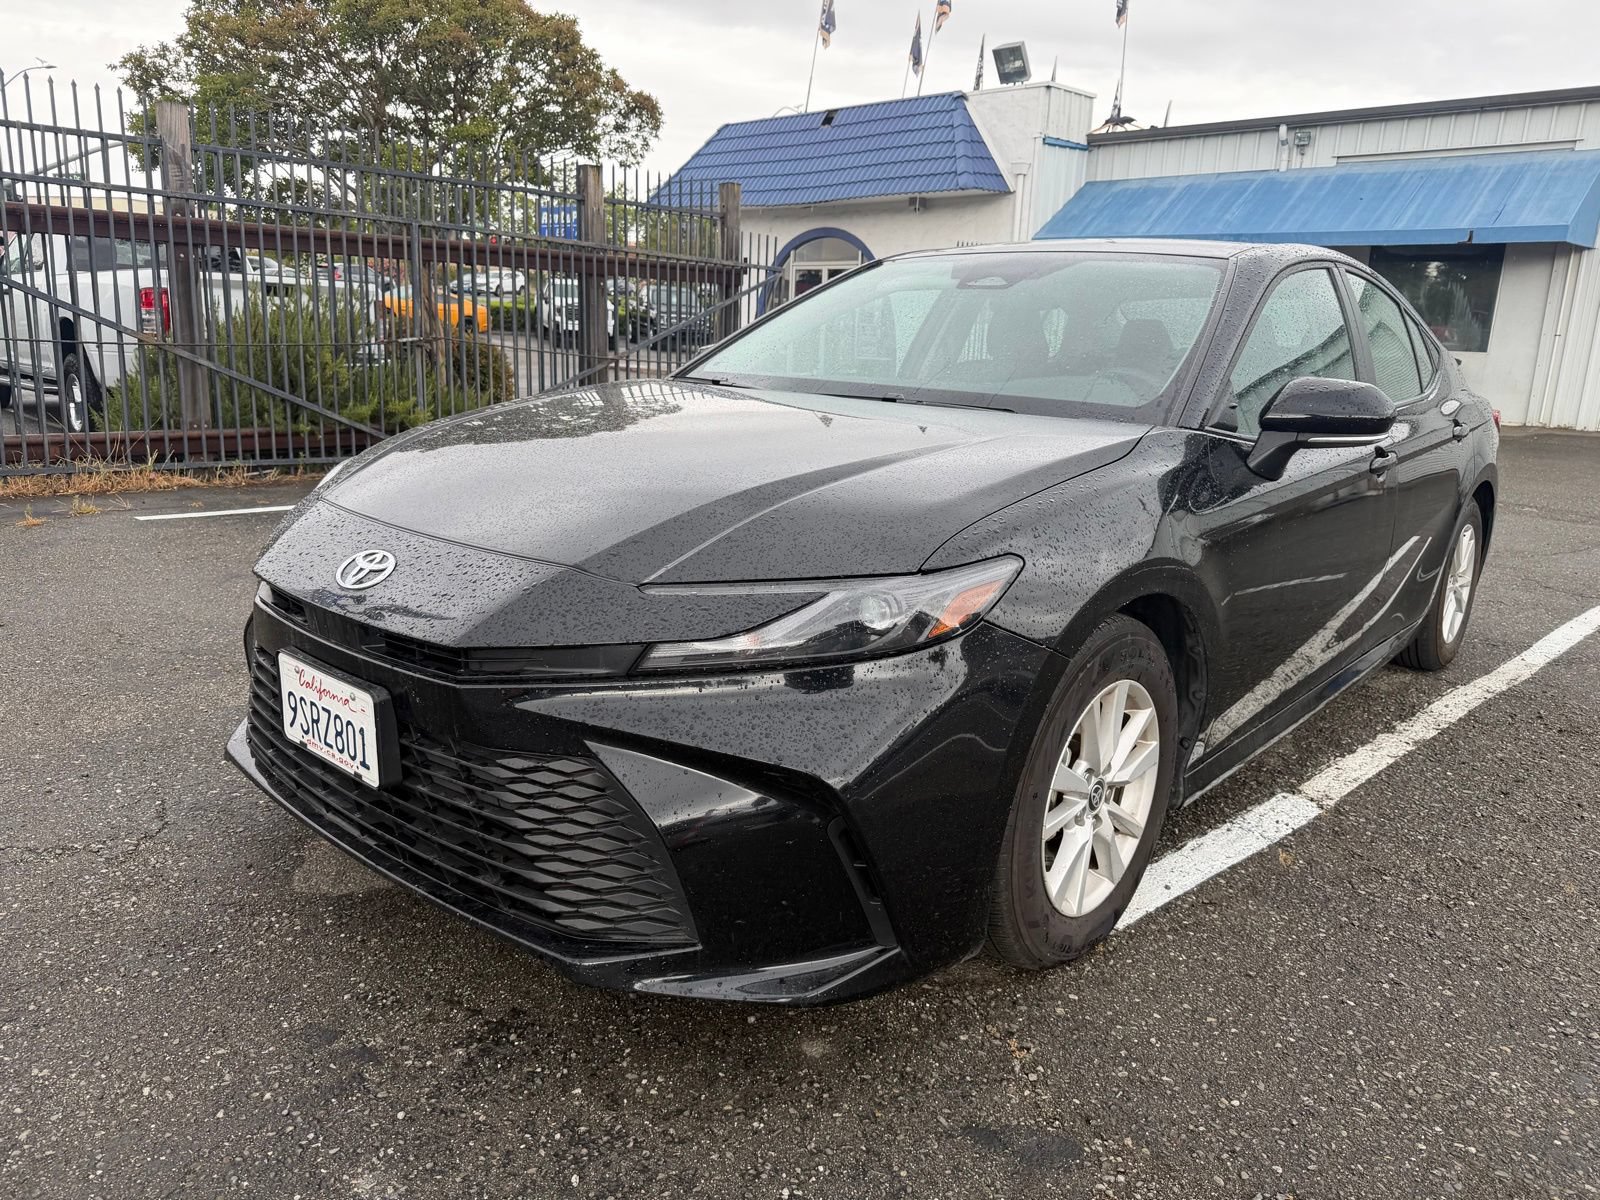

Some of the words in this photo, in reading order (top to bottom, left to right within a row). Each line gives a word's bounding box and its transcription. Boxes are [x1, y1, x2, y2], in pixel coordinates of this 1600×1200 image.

[298, 669, 356, 713] California
[287, 690, 370, 771] 9SRZ801
[306, 738, 354, 770] dmv.ca.gov
